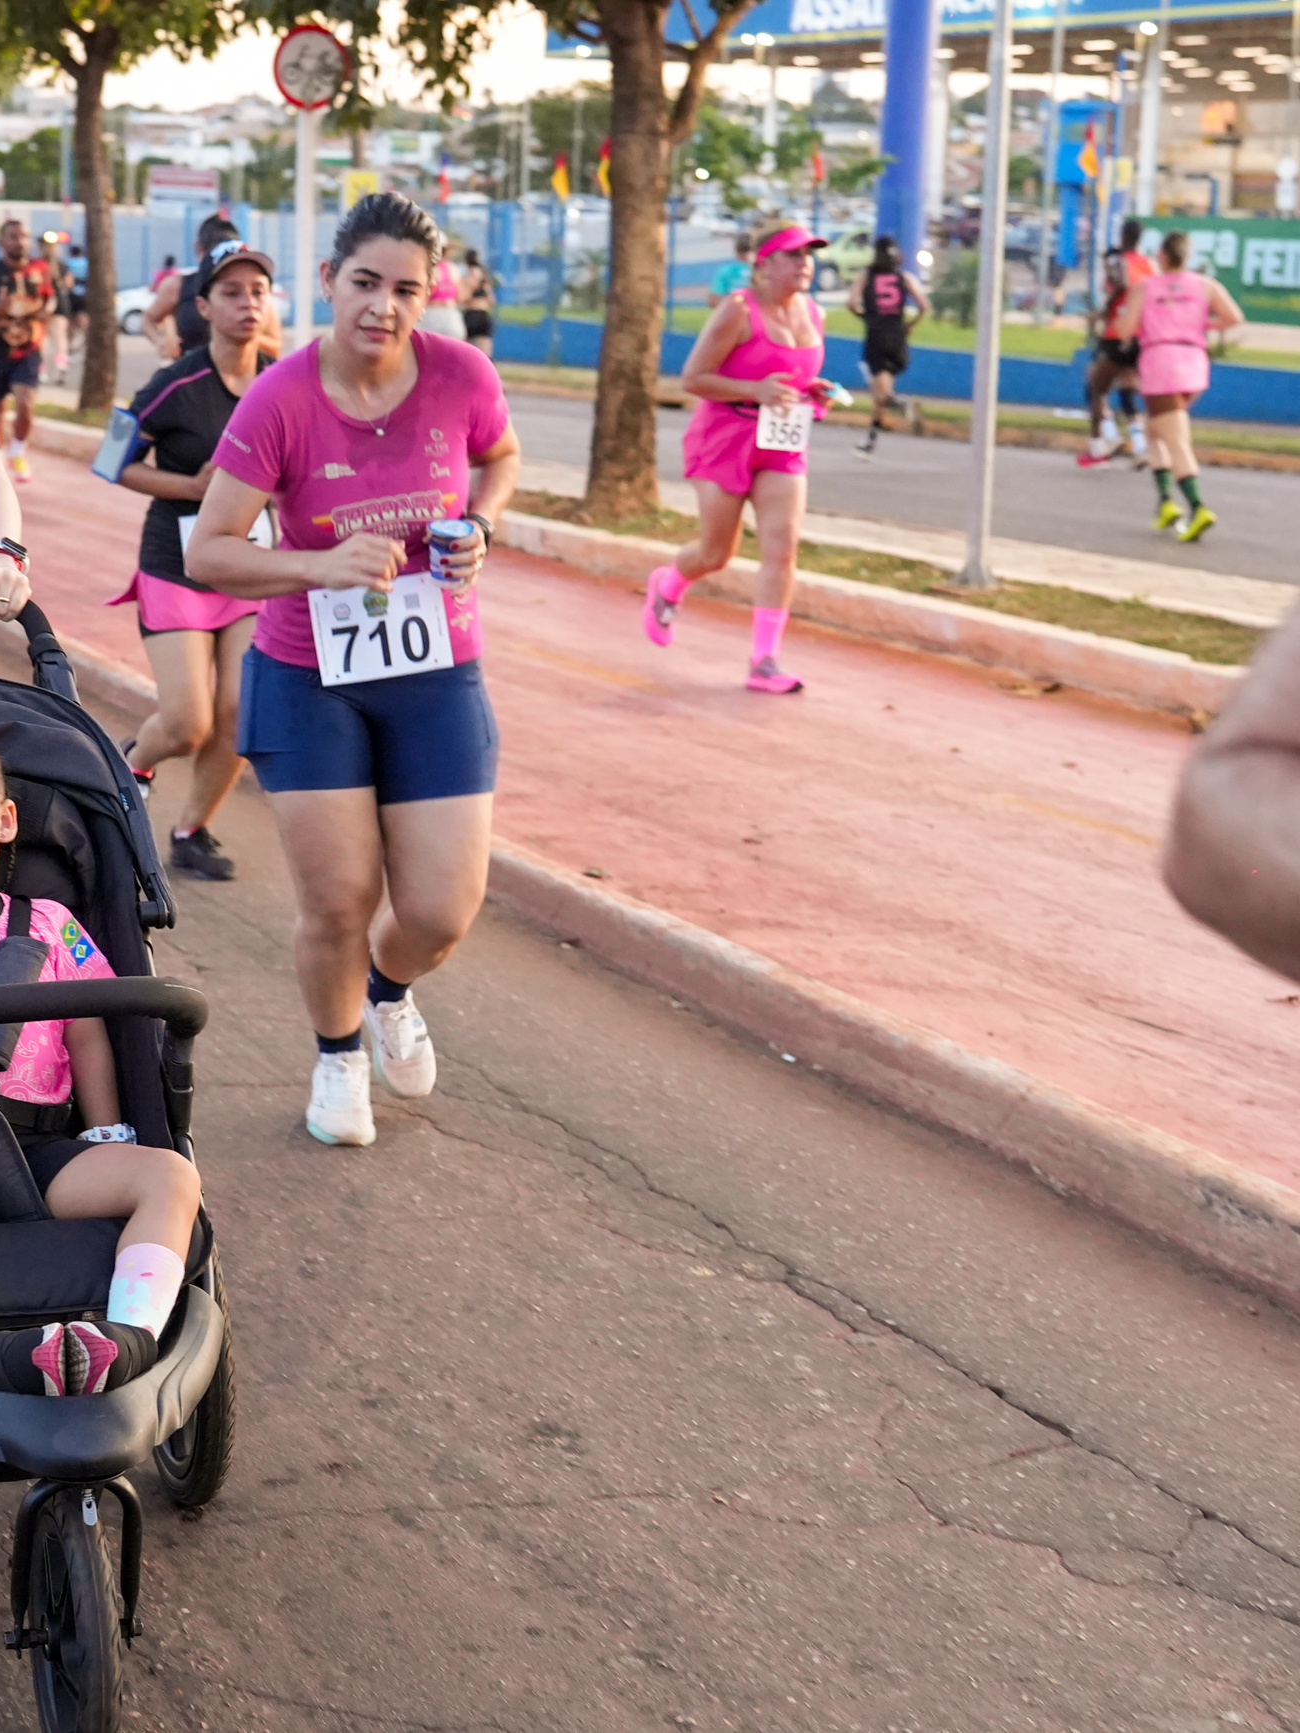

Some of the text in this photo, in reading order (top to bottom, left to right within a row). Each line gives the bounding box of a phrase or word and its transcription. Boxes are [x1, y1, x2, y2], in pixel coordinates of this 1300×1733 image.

[1241, 238, 1300, 288] FEI
[764, 421, 802, 446] 356
[331, 616, 431, 673] 710
